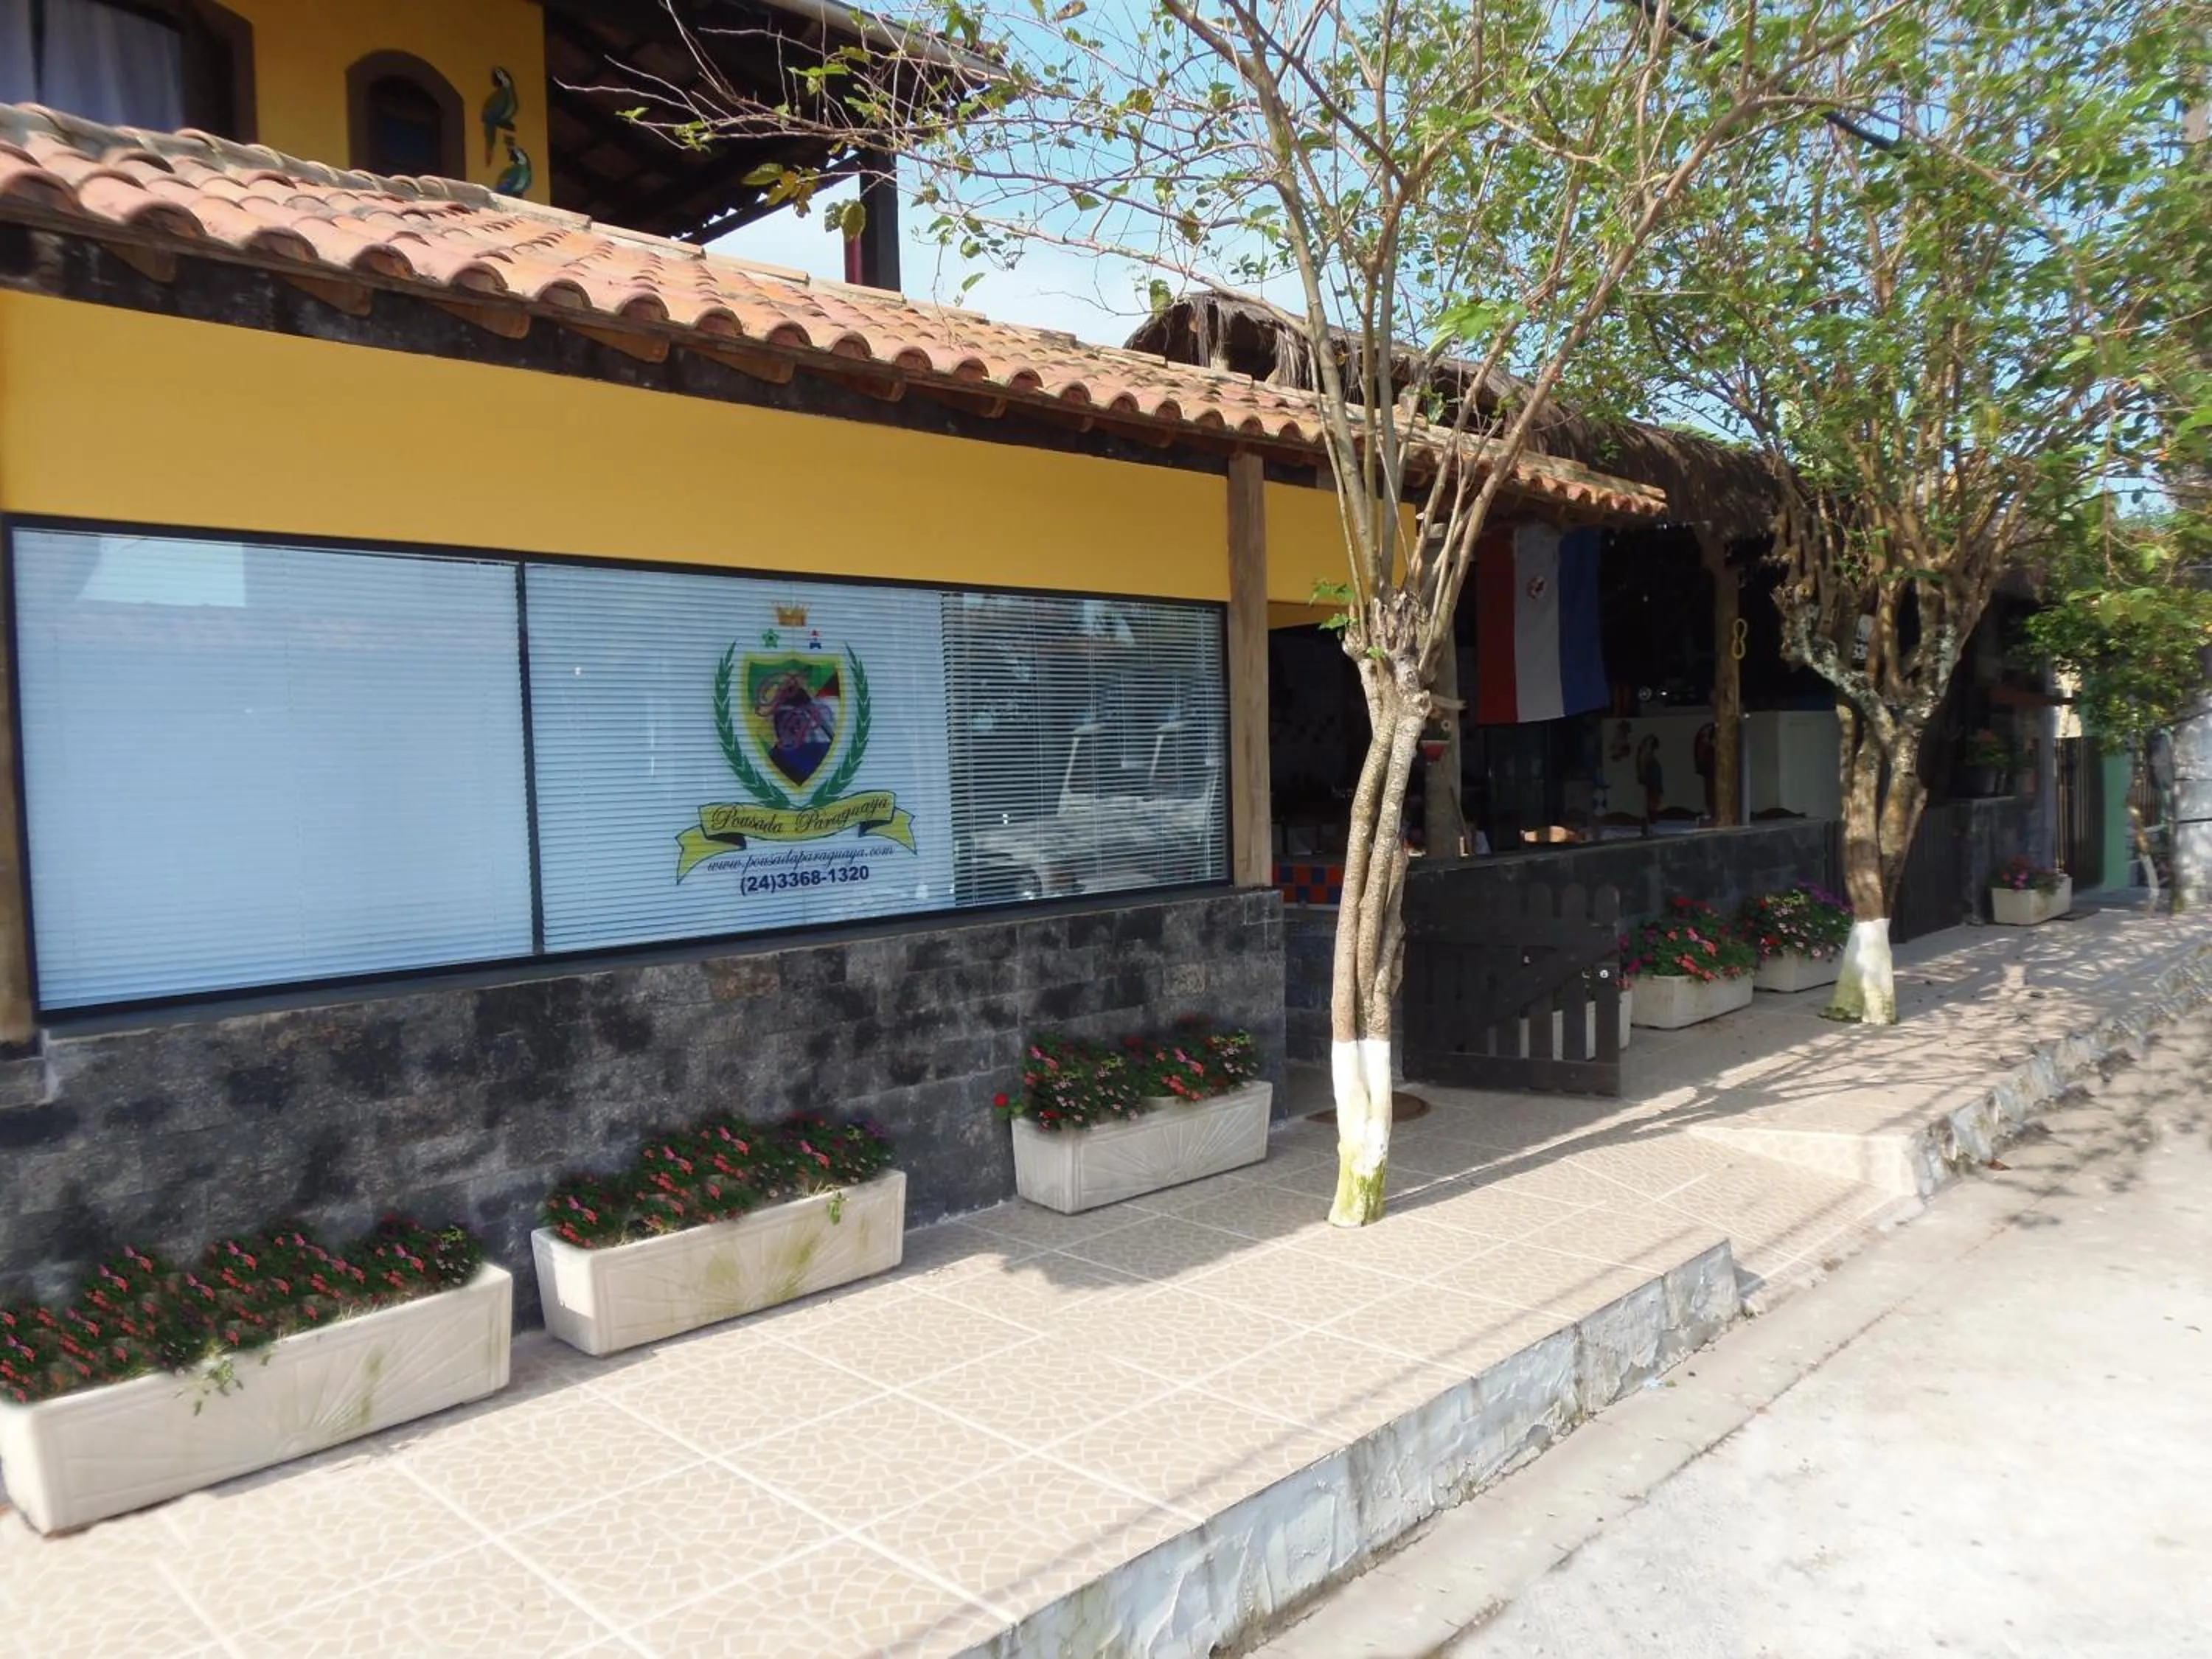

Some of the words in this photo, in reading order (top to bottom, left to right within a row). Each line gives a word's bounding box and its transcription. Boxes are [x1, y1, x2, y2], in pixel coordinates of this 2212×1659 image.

[711, 805, 784, 833] Pousada
[706, 846, 894, 874] www.pousadaparaguaya.com
[740, 865, 870, 897] (24)3368-1320
